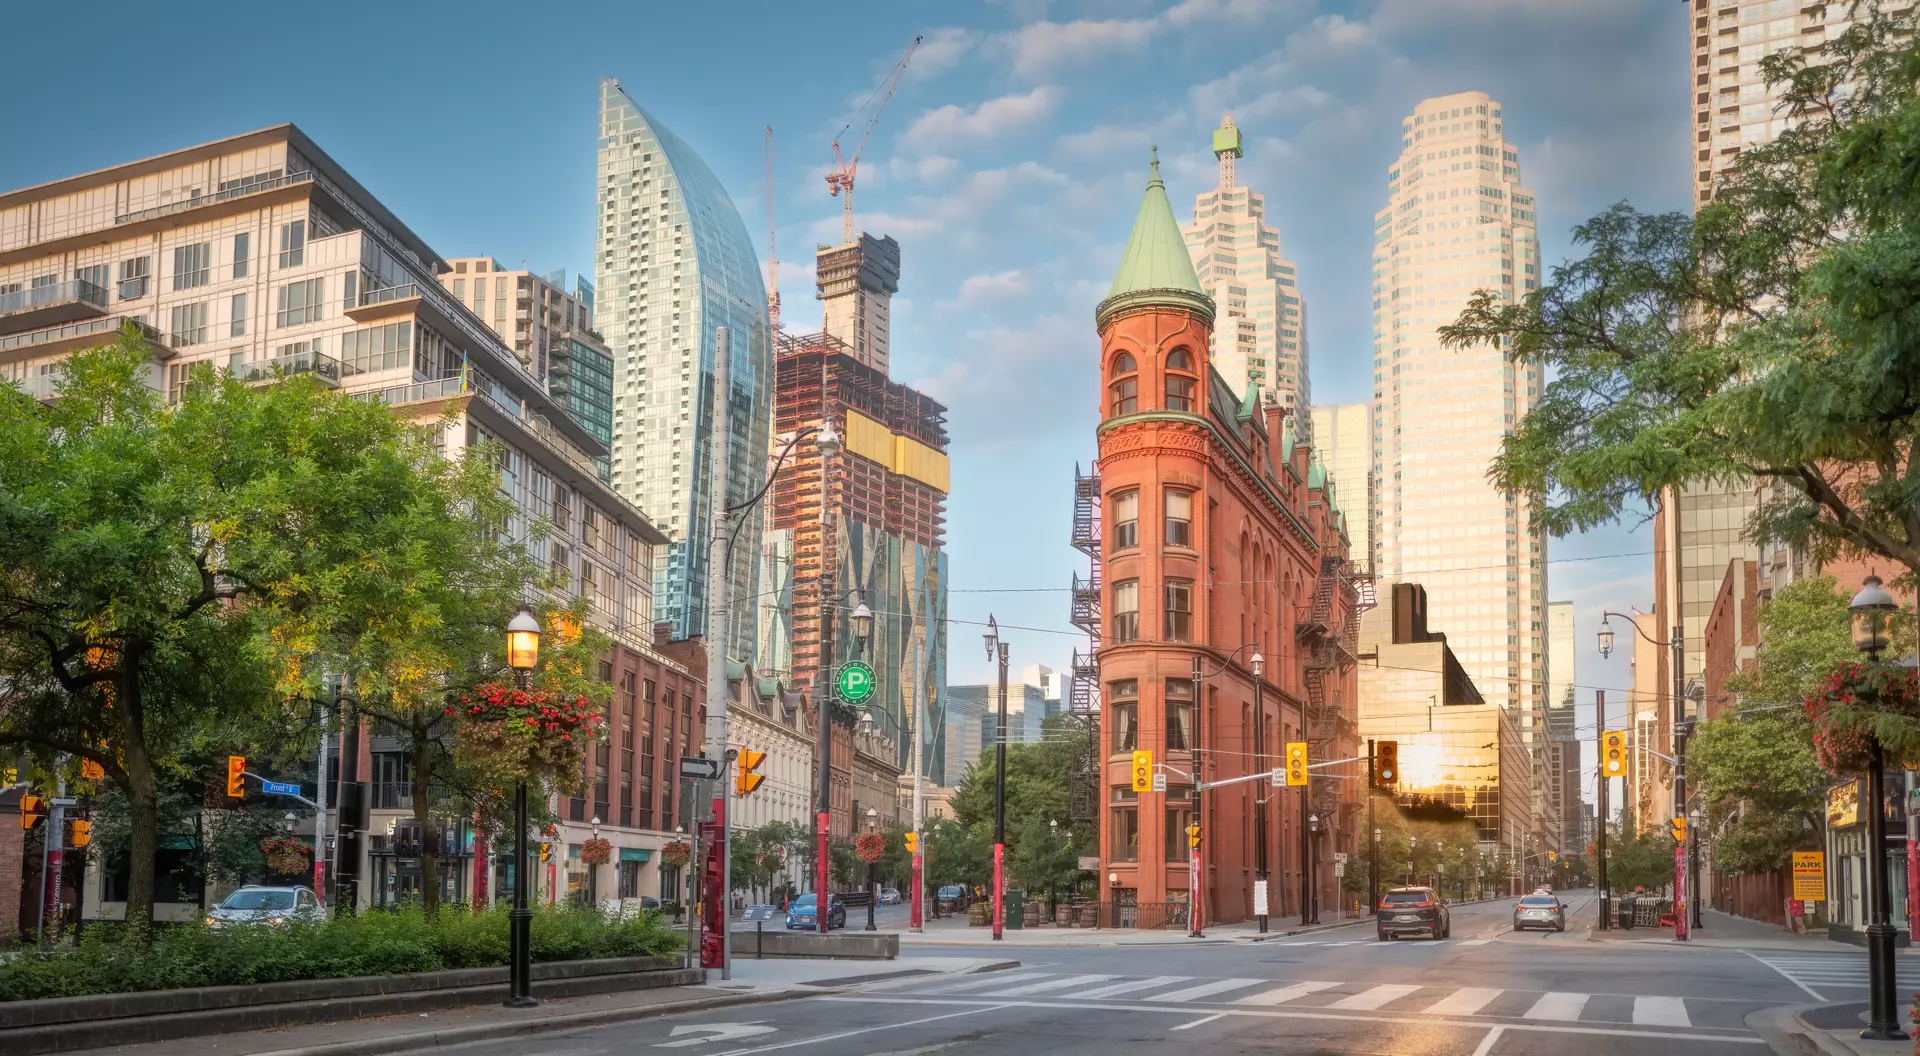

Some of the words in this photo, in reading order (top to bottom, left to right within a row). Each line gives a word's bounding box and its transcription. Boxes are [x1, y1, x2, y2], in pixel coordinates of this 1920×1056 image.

[836, 662, 874, 682] MUNICIPAL
[848, 672, 864, 690] P
[836, 686, 874, 704] PARKING
[270, 783, 285, 792] Front
[1794, 861, 1822, 869] PARK
